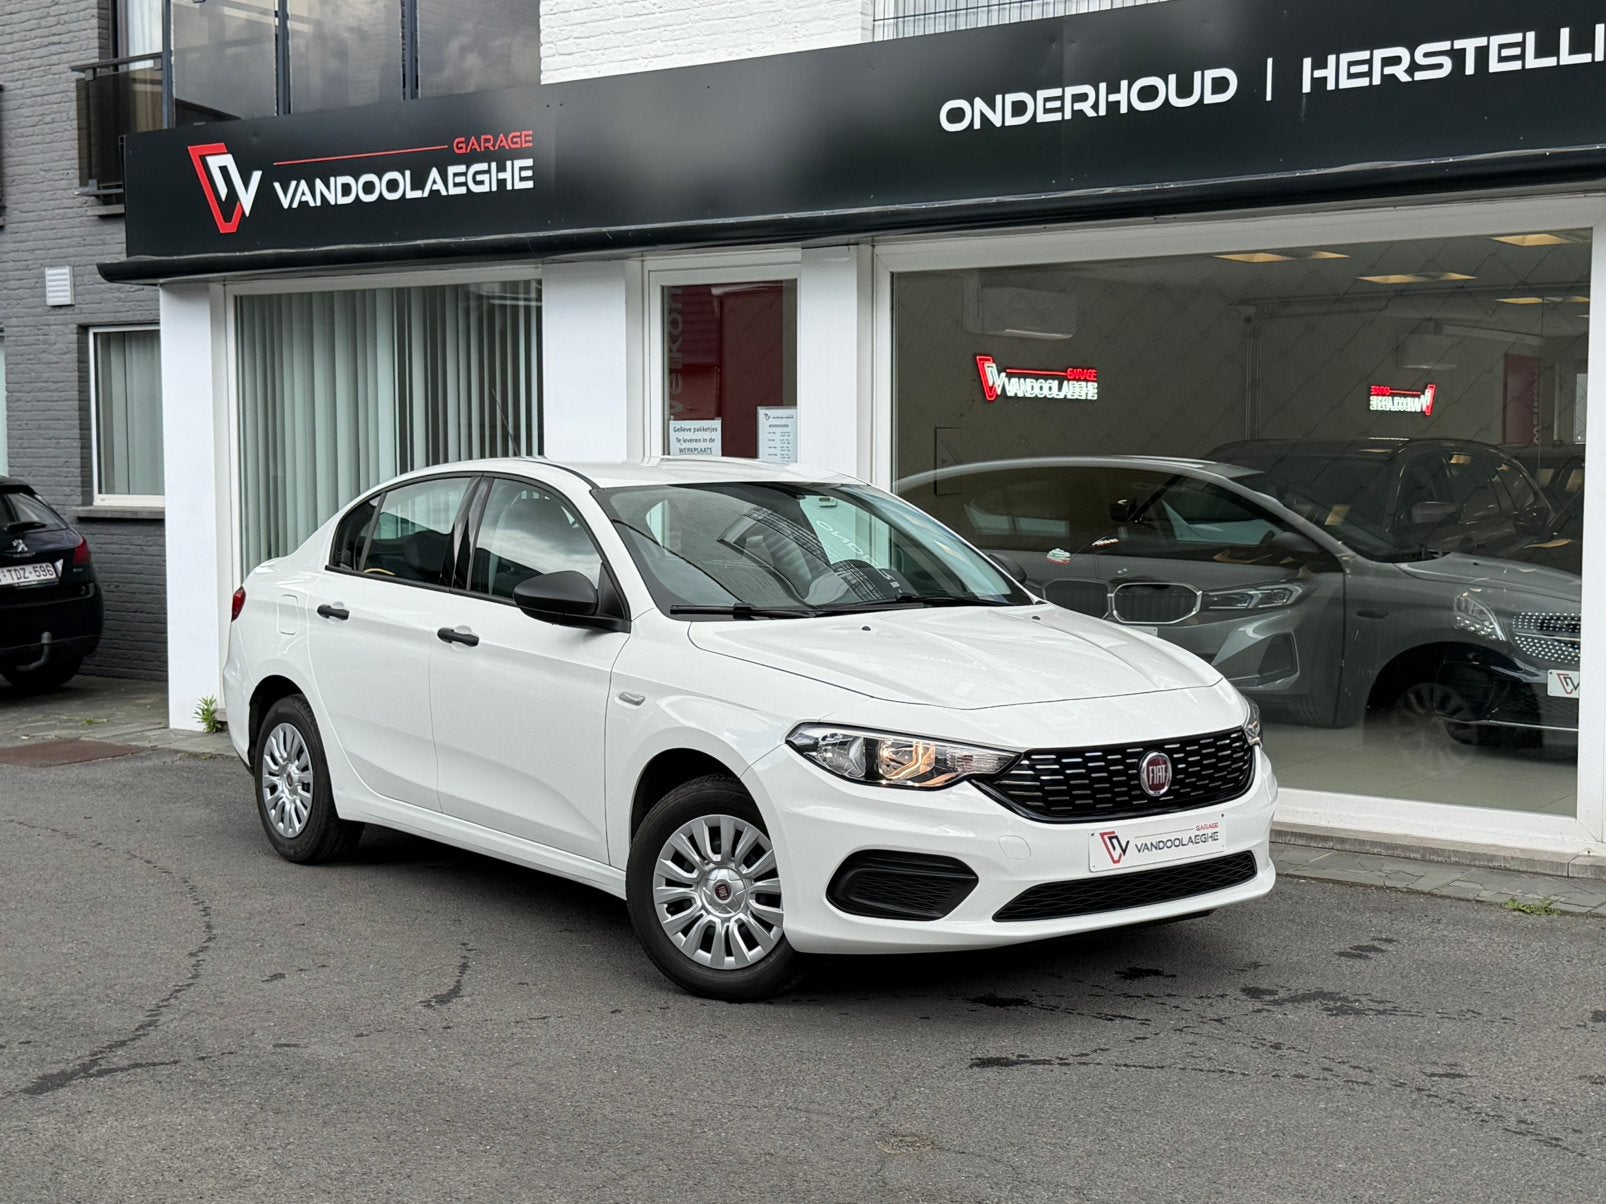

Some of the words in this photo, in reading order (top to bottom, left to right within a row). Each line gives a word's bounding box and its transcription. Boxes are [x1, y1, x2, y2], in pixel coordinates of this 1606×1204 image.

[939, 67, 1238, 133] ONDERHOUD
[1302, 23, 1606, 94] HERSTELLI
[453, 130, 533, 154] GARAGE
[273, 158, 534, 210] VANDOOLAEGHE
[1149, 764, 1167, 785] FIAT
[1135, 831, 1219, 853] VANDOOLAEGHE
